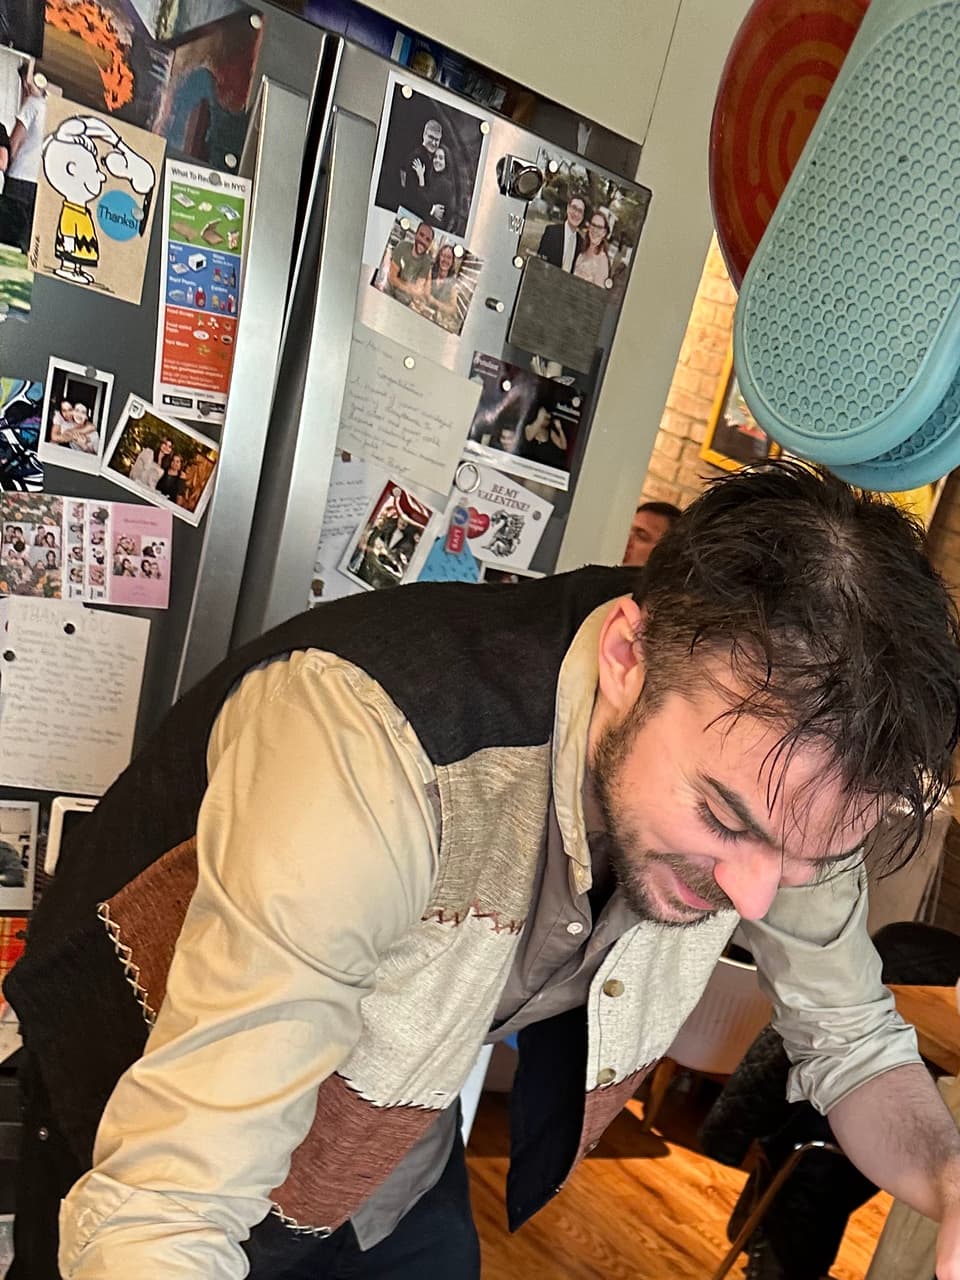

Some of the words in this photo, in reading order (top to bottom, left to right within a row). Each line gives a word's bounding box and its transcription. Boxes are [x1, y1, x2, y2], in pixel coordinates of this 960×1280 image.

[171, 167, 188, 177] What
[231, 182, 246, 193] NYC
[98, 204, 138, 231] Thanks!
[504, 488, 520, 499] MY
